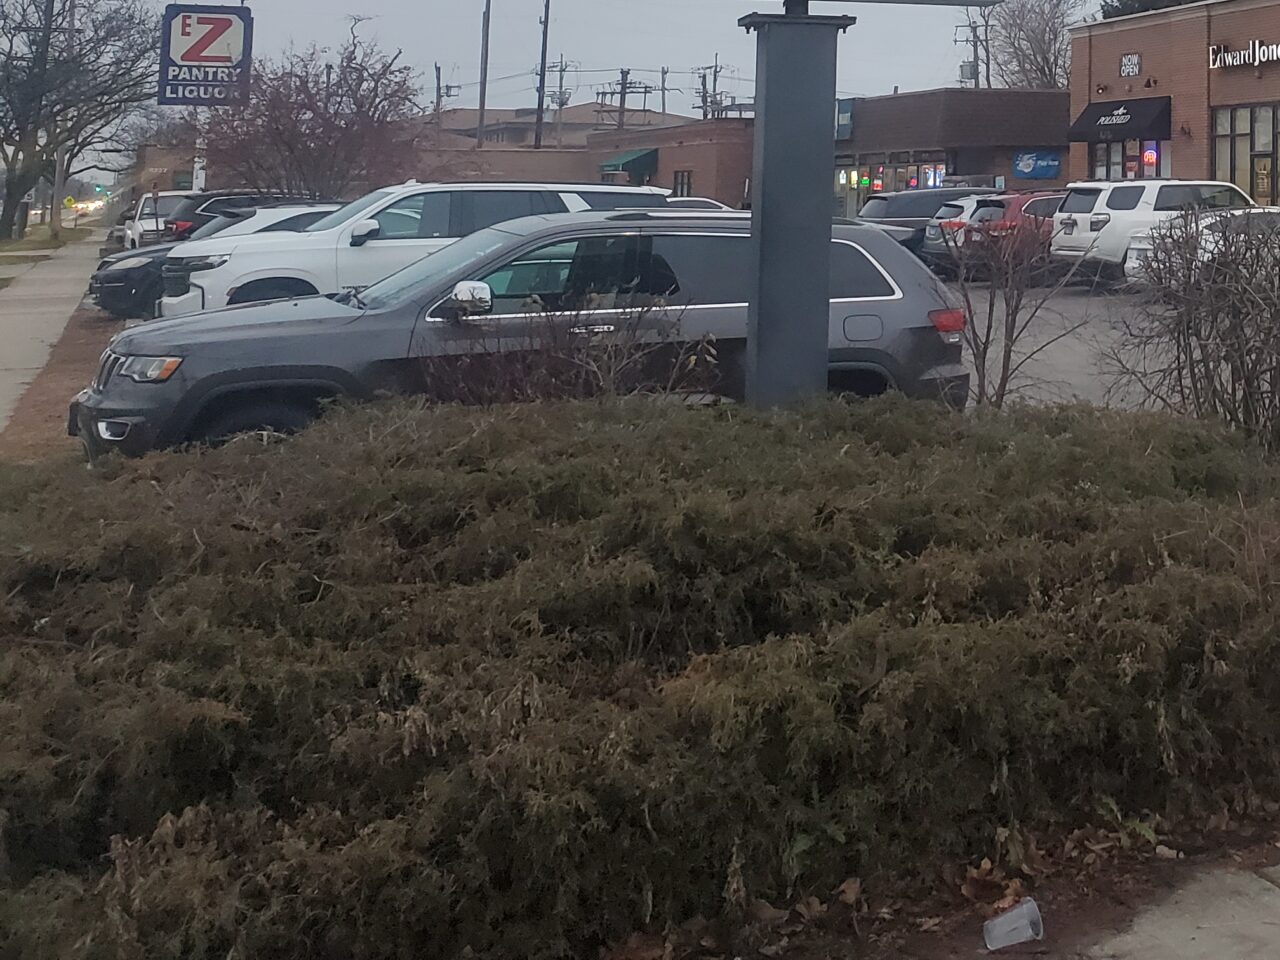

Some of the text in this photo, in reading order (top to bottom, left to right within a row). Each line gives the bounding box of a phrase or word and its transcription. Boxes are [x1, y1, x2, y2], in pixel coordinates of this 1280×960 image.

[1121, 54, 1139, 65] NOW
[168, 66, 241, 81] PANTRY
[1120, 65, 1139, 77] OPEN
